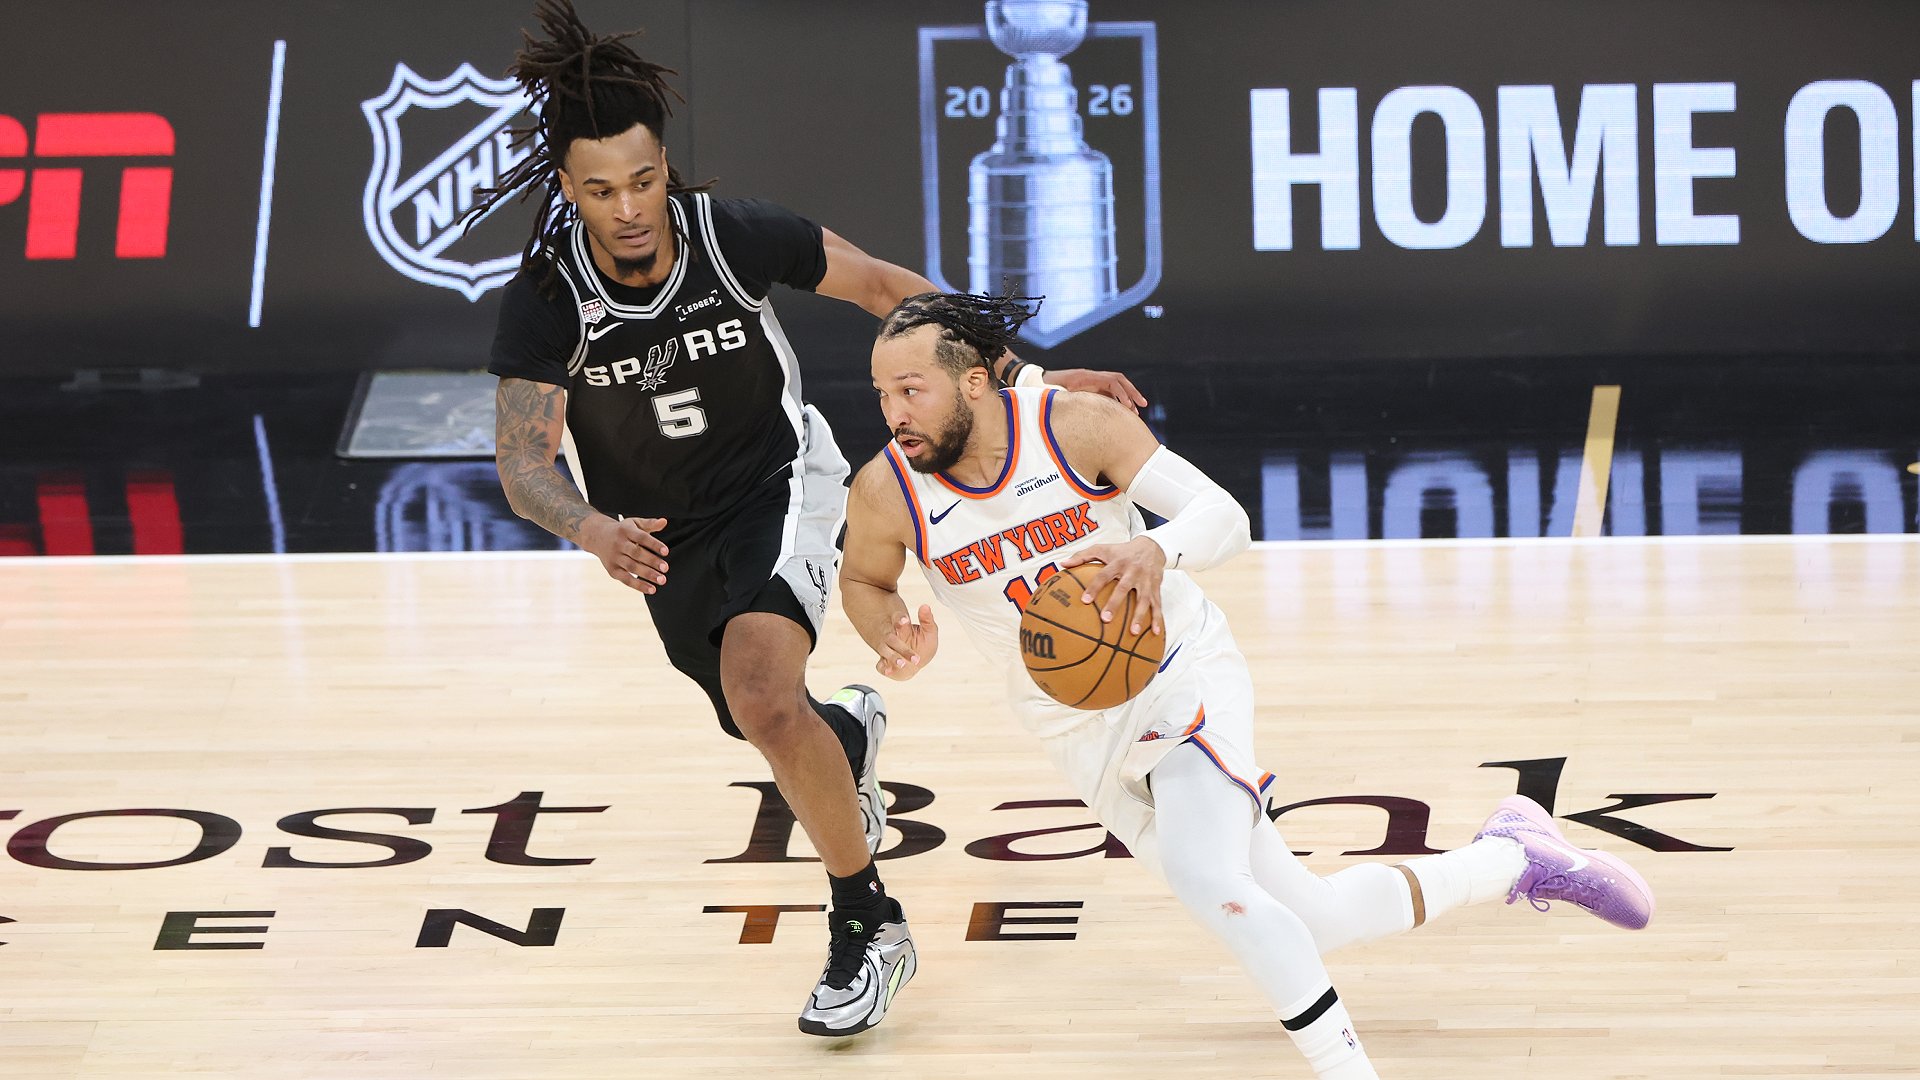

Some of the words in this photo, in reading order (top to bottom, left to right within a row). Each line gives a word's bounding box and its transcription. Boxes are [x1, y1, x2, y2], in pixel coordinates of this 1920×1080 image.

[945, 86, 990, 118] 20
[1088, 84, 1133, 116] 26
[1250, 81, 1740, 251] HOME
[1784, 79, 1920, 244] O
[682, 296, 716, 316] LEDGER
[583, 318, 747, 392] SPURS
[651, 387, 709, 439] 5
[1016, 484, 1034, 497] abu
[1034, 471, 1060, 489] dhabi
[932, 533, 1006, 585] NEW
[1003, 502, 1099, 562] YORK
[0, 790, 612, 871] ost
